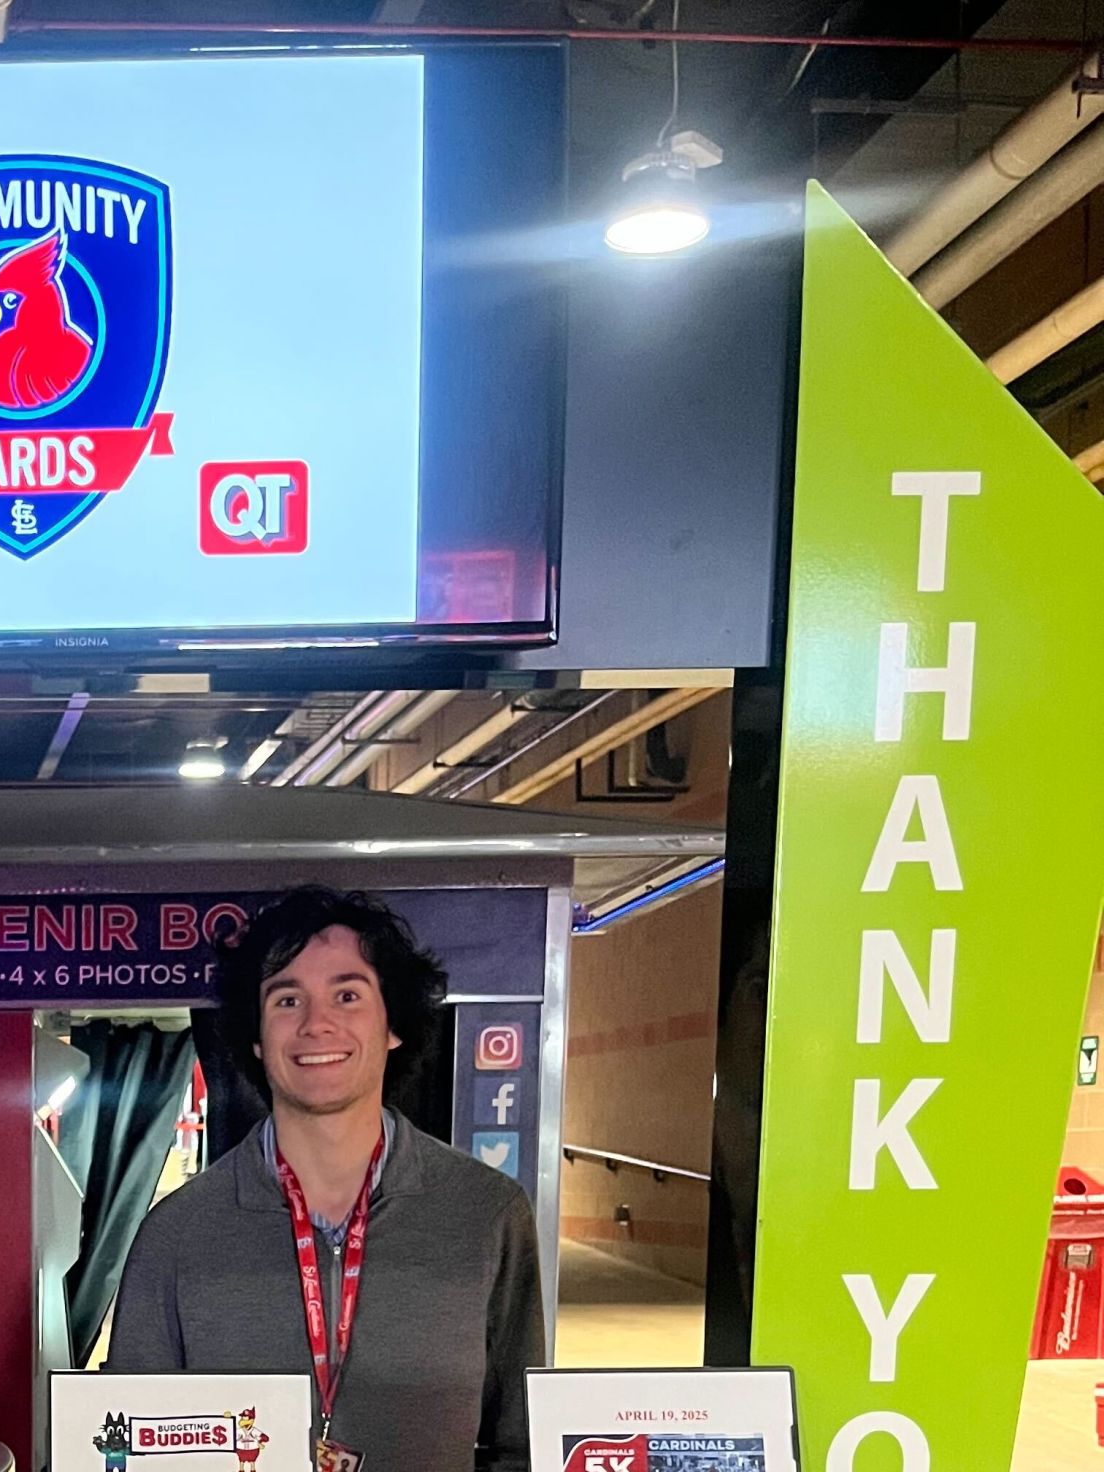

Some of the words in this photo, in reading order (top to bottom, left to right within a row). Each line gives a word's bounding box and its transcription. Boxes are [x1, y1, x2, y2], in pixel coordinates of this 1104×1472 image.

[210, 473, 294, 543] QT
[54, 636, 110, 648] INSIGNIA
[848, 471, 982, 1190] THANK
[54, 965, 70, 986] 6
[79, 964, 187, 985] PHOTOS
[614, 1410, 658, 1422] APRIL
[661, 1410, 678, 1423] 19,
[681, 1410, 709, 1421] 2025
[157, 1422, 211, 1434] BUDGETING
[138, 1424, 228, 1447] BUDDIE$
[648, 1439, 735, 1451] CARDINALS
[583, 1448, 635, 1456] CARDINALS
